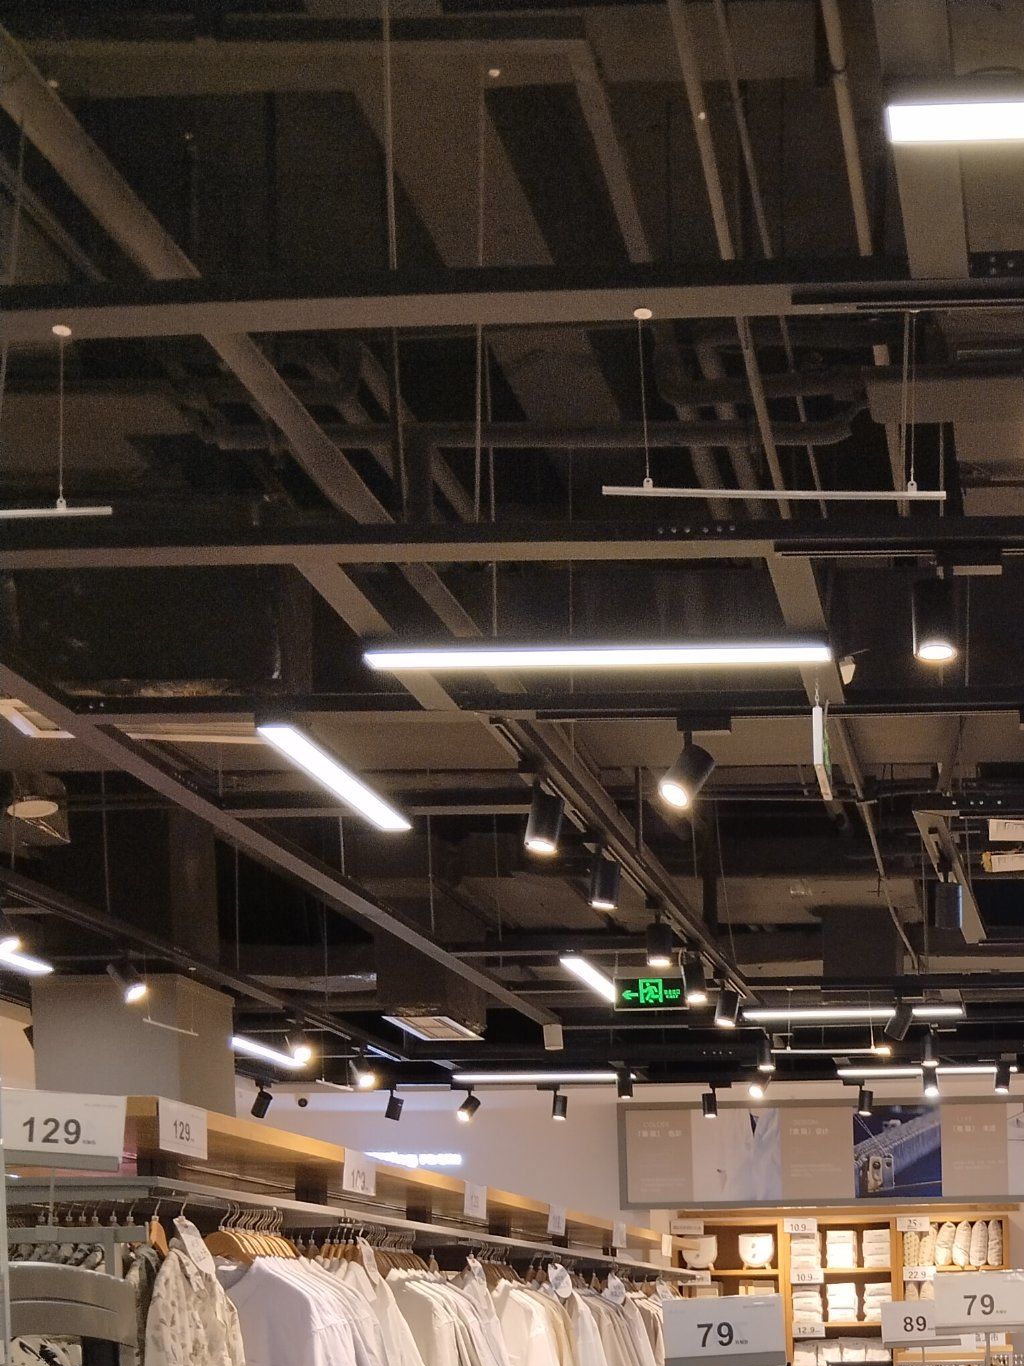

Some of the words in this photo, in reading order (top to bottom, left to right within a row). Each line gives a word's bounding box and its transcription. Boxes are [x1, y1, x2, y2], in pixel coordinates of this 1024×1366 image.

[22, 1116, 82, 1145] 129
[173, 1120, 191, 1142] 129
[790, 1223, 807, 1232] 10.9
[963, 1293, 995, 1316] 79
[697, 1321, 734, 1348] 79
[903, 1315, 927, 1332] 89
